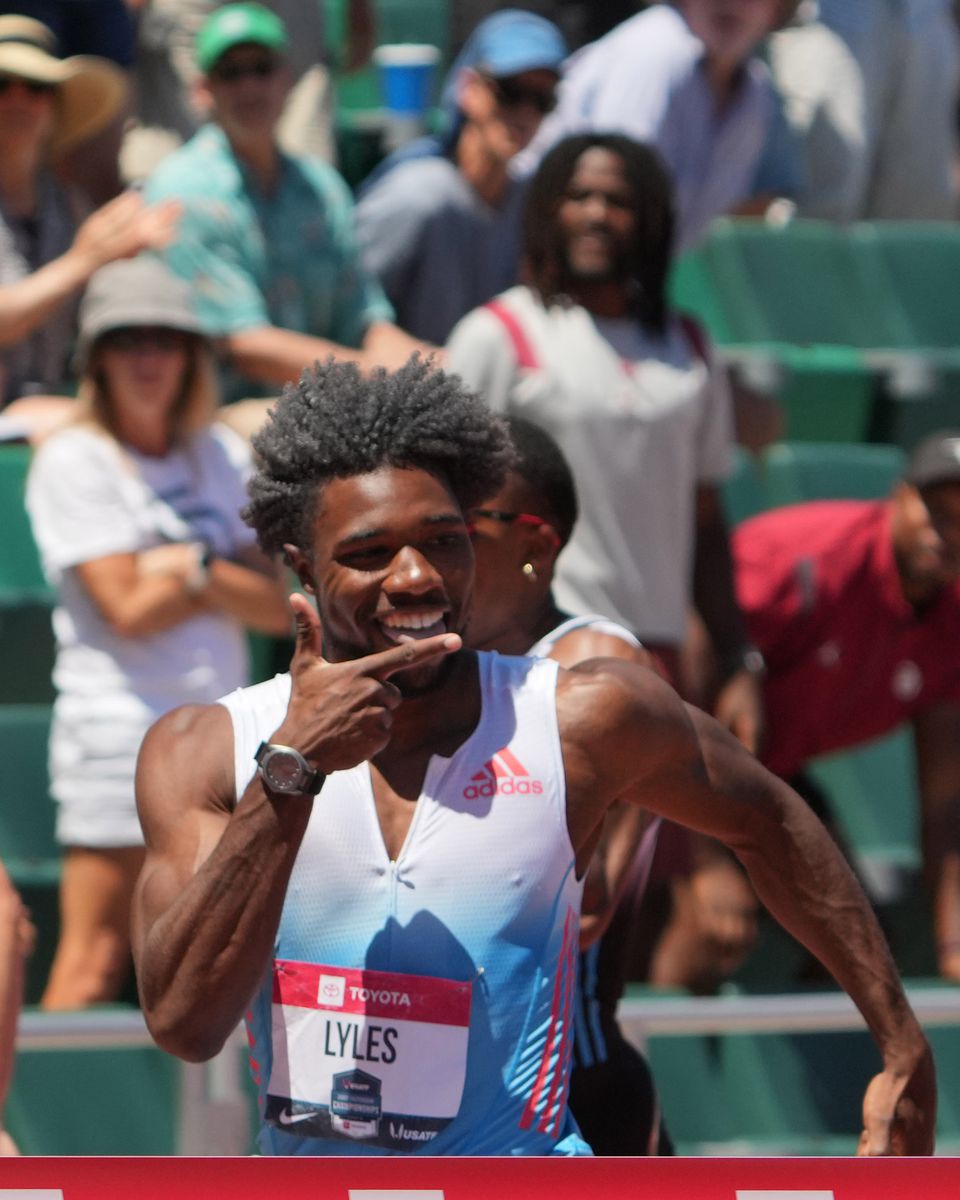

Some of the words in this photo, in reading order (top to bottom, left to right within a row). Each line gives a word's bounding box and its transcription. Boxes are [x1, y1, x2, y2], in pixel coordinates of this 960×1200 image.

[463, 778, 544, 800] adidas
[348, 986, 412, 1008] TOYOTA
[324, 1020, 399, 1065] LYLES
